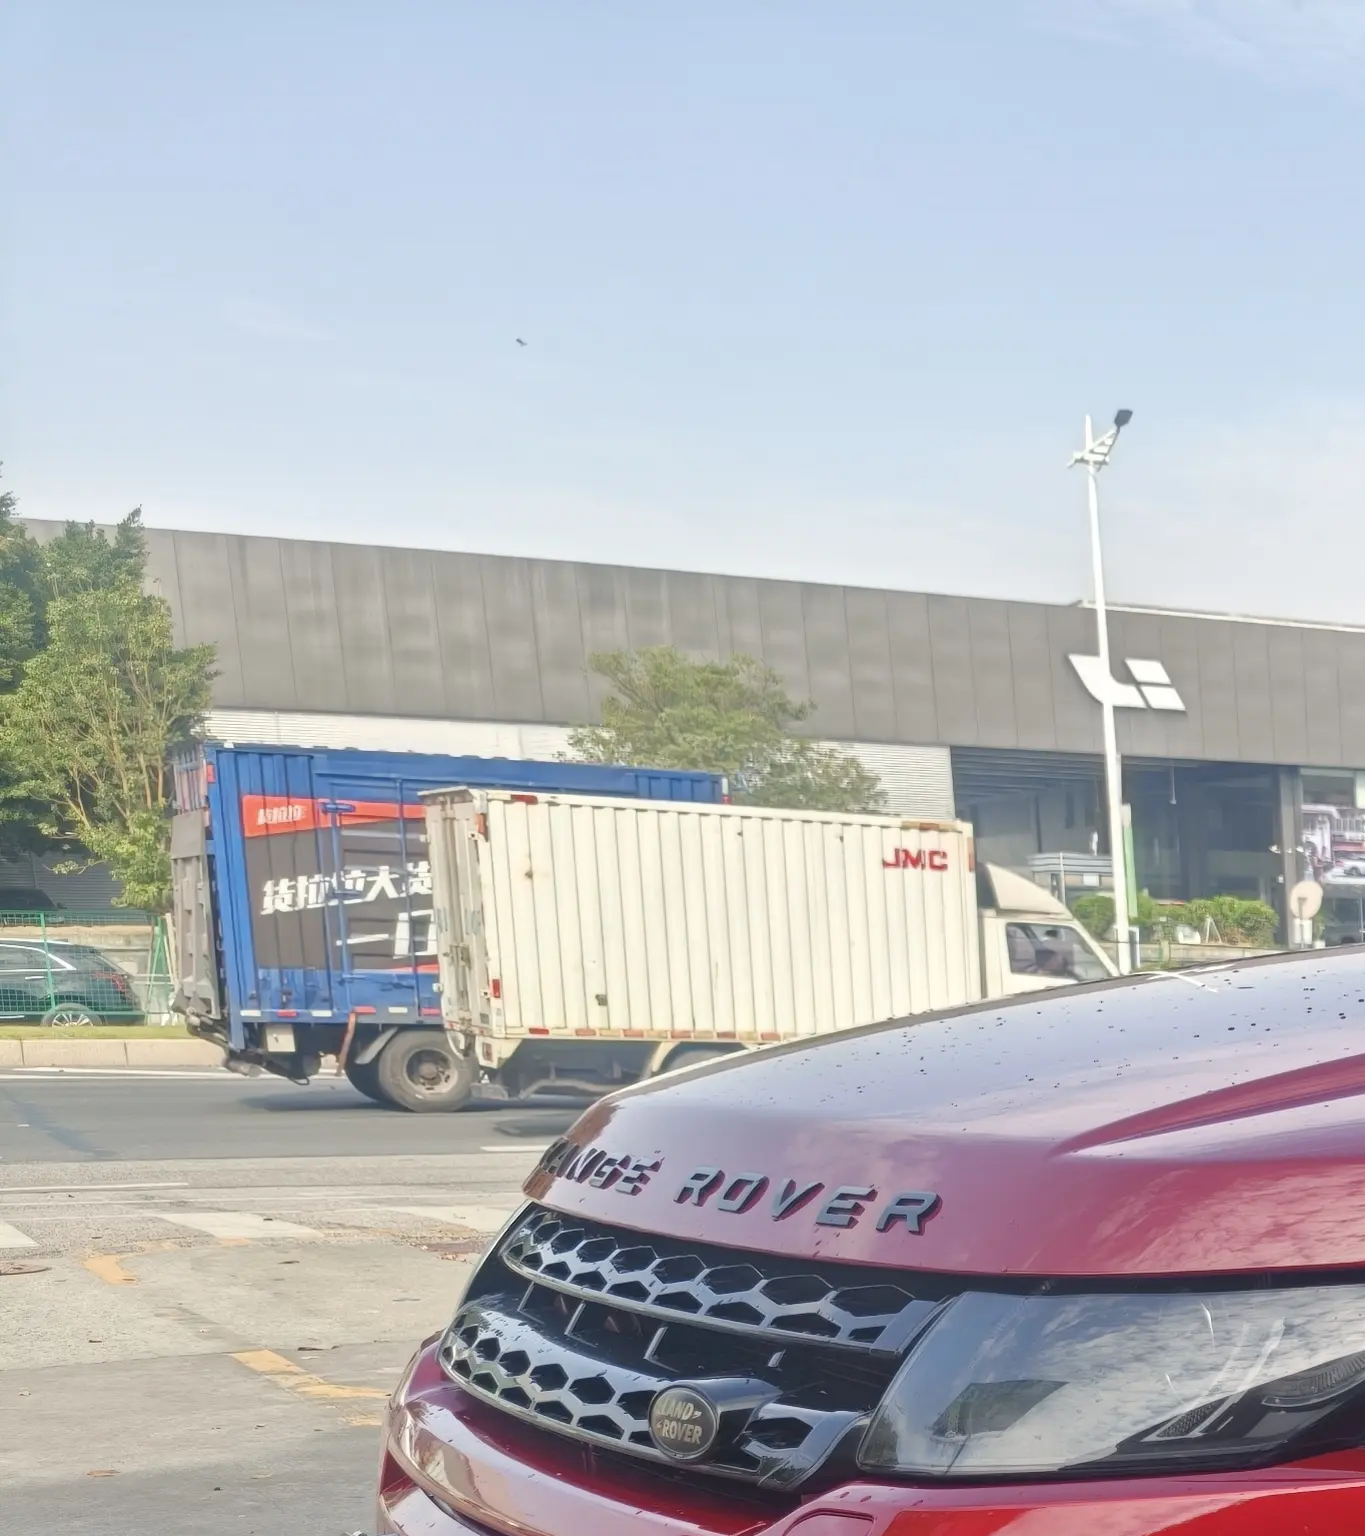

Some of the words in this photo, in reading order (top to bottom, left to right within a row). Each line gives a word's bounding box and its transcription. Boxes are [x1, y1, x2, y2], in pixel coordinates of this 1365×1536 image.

[882, 848, 949, 871] JMC
[673, 1165, 943, 1236] ROVER
[658, 1397, 696, 1421] LAND
[662, 1419, 703, 1445] ROVER
